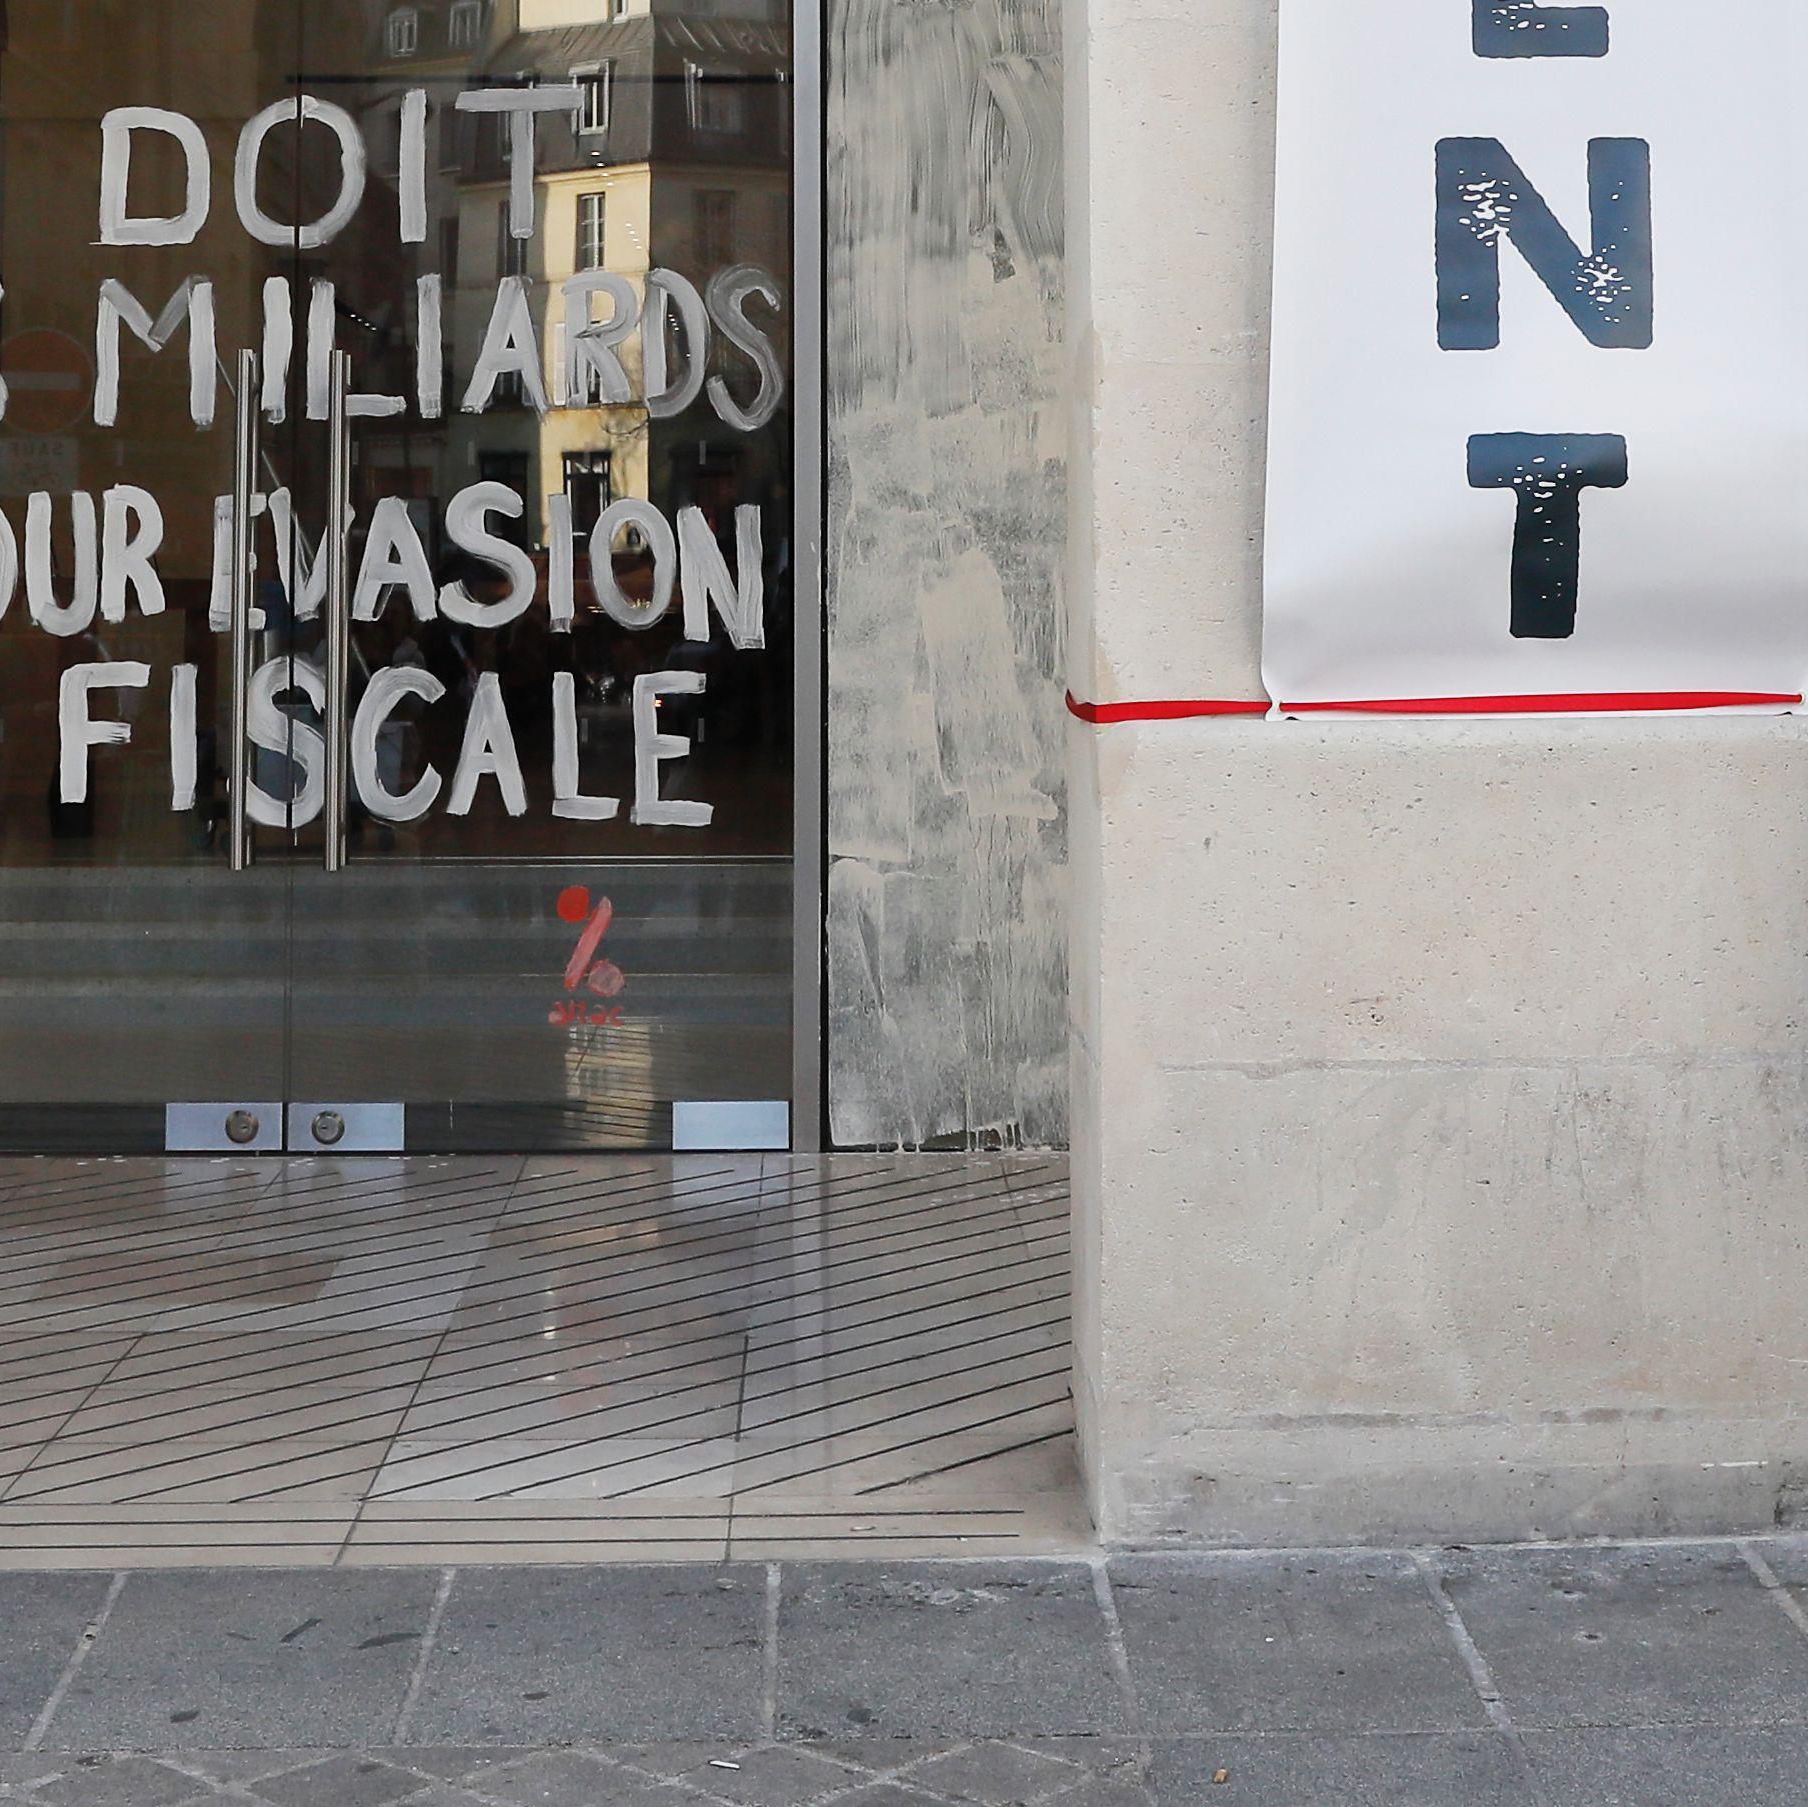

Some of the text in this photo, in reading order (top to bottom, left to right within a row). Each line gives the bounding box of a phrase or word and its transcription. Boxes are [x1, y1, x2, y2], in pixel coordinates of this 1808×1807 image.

[89, 88, 585, 248] DOIT
[209, 480, 766, 651] EVASION
[59, 655, 715, 828] FISCALE
